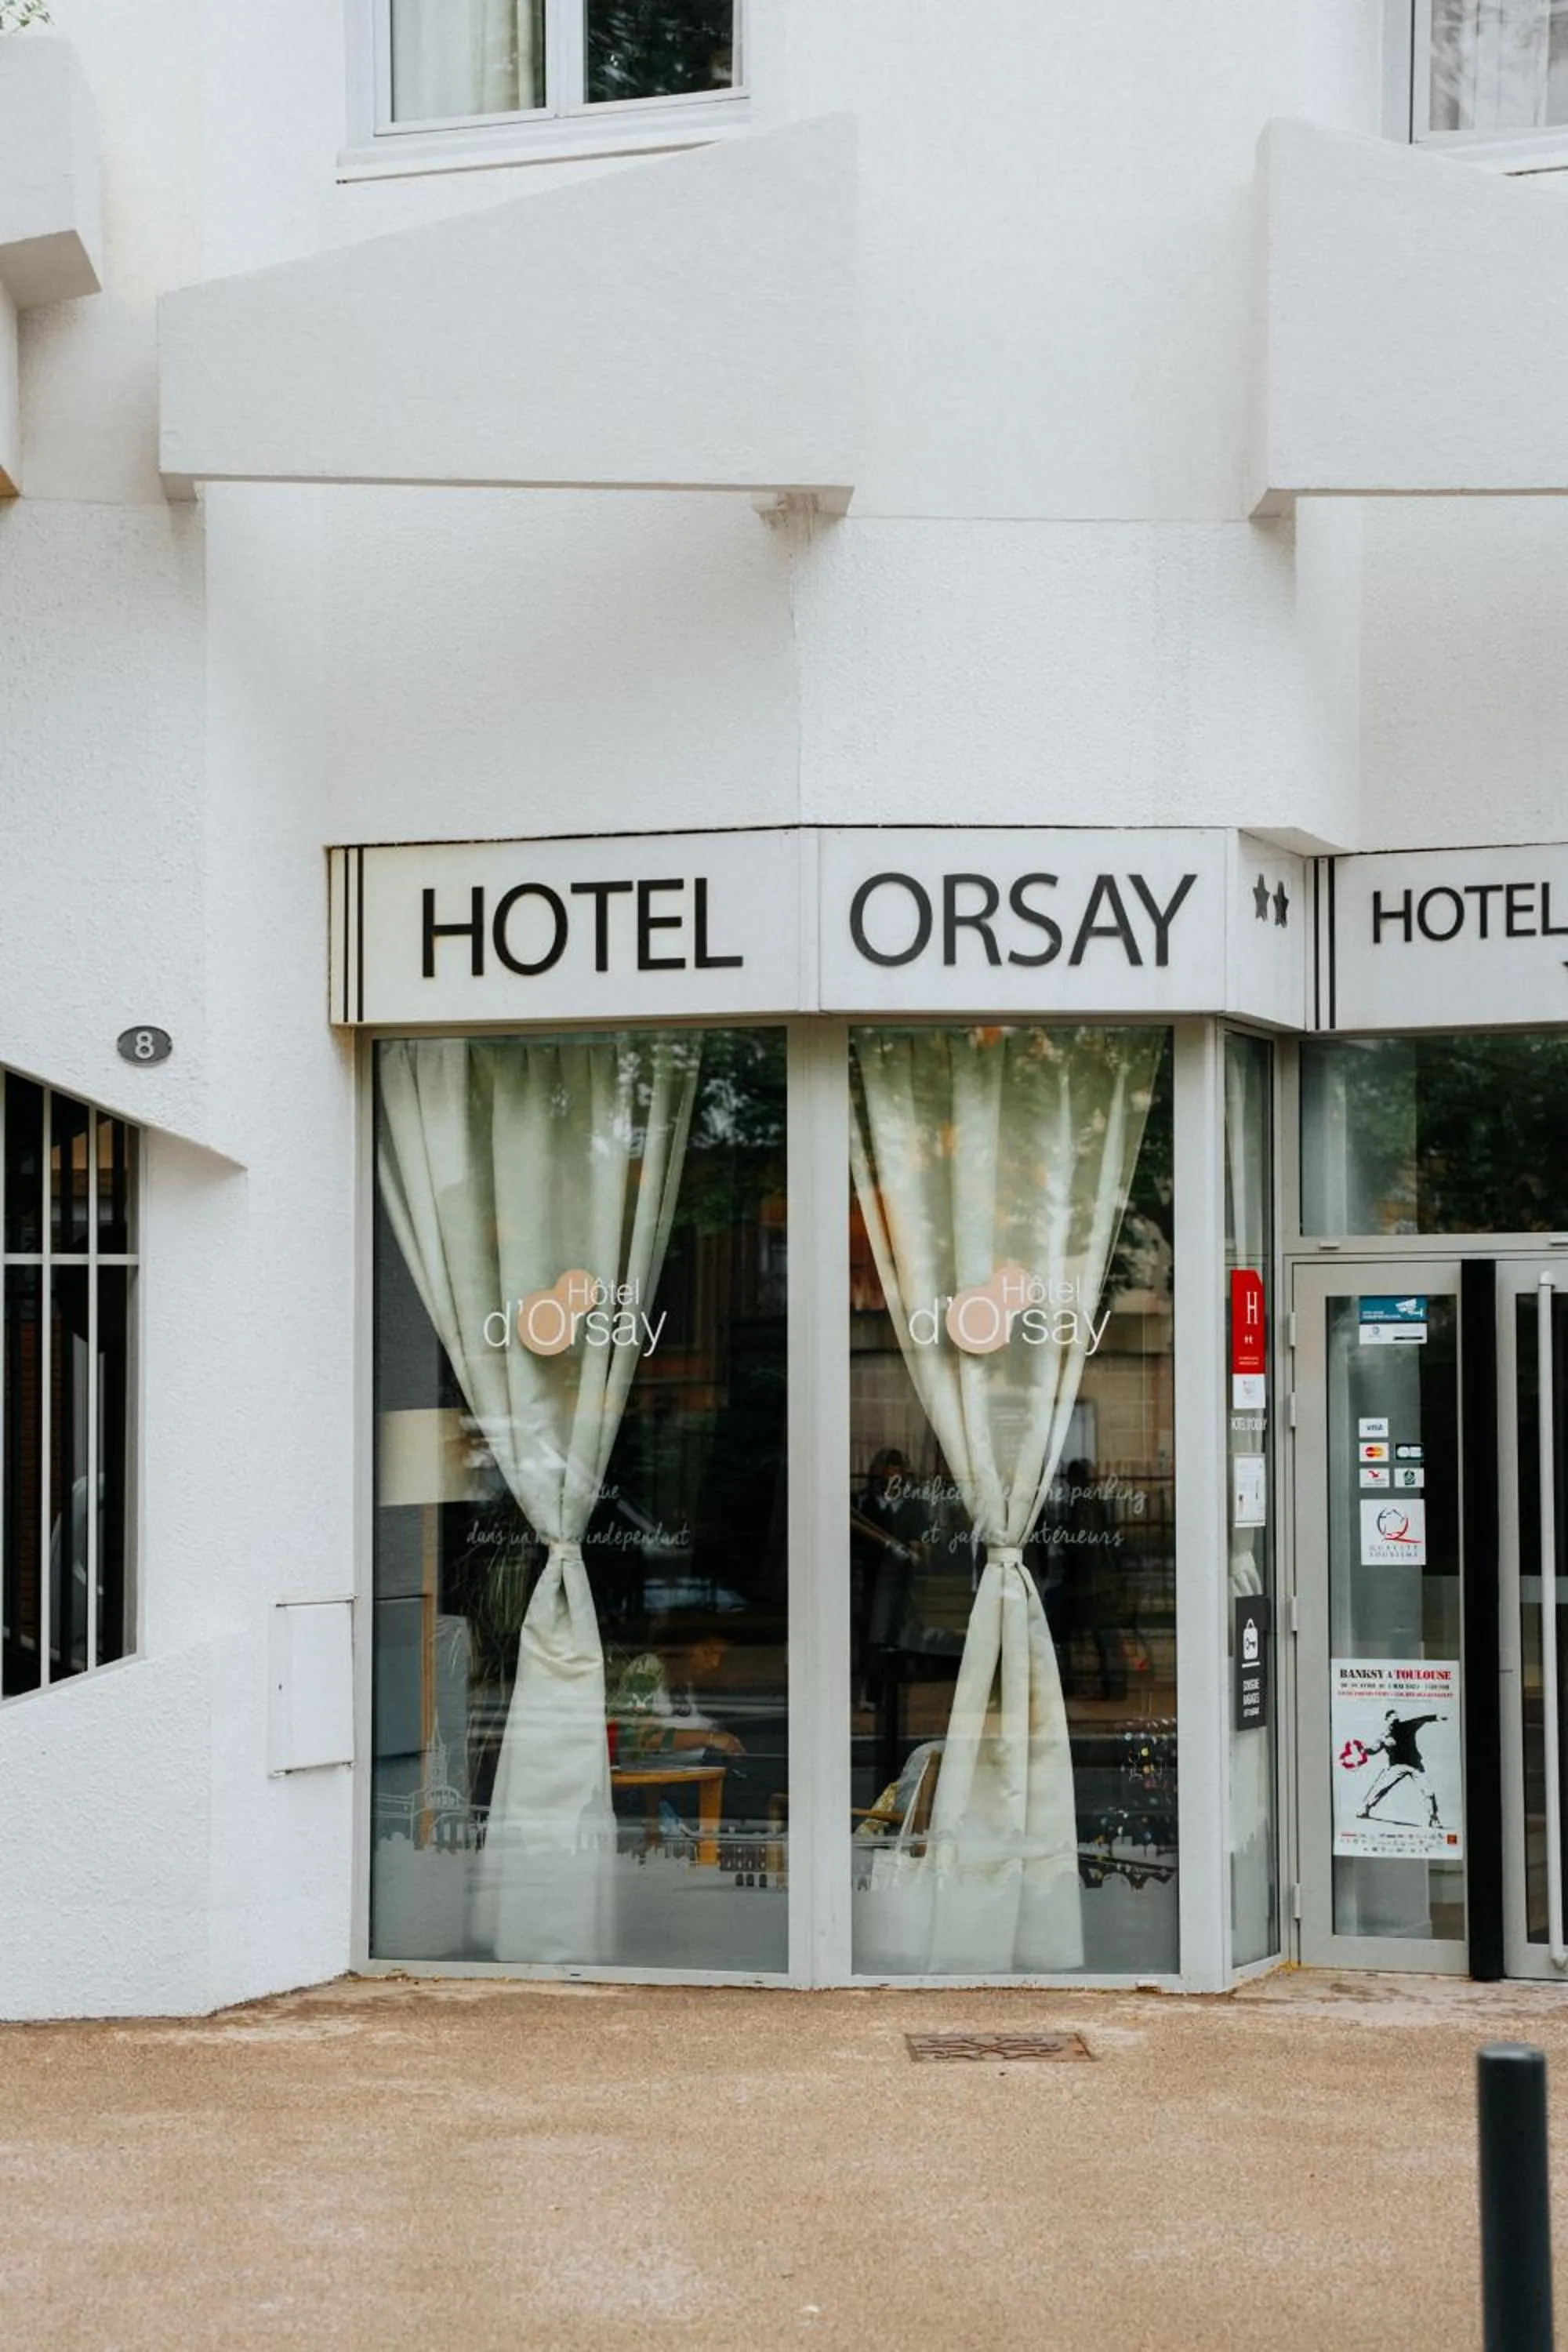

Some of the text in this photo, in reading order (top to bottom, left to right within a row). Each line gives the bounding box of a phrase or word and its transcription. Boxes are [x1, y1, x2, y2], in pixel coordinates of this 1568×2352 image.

[422, 872, 1198, 978] HOTEL ORSAY
[1372, 882, 1568, 943] HOTEL
[134, 1030, 154, 1059] 8
[568, 1277, 640, 1306] Hôtel
[1002, 1275, 1081, 1305] Hôtel
[1246, 1291, 1258, 1325] H
[483, 1298, 667, 1357] d'Orsay
[908, 1296, 1112, 1356] d'Orsay
[1070, 1473, 1146, 1514] parking
[922, 1519, 941, 1544] et
[1027, 1521, 1124, 1548] ntérieurs
[1340, 1668, 1383, 1679] BANKSY
[1396, 1669, 1451, 1680] TOULOUSE
